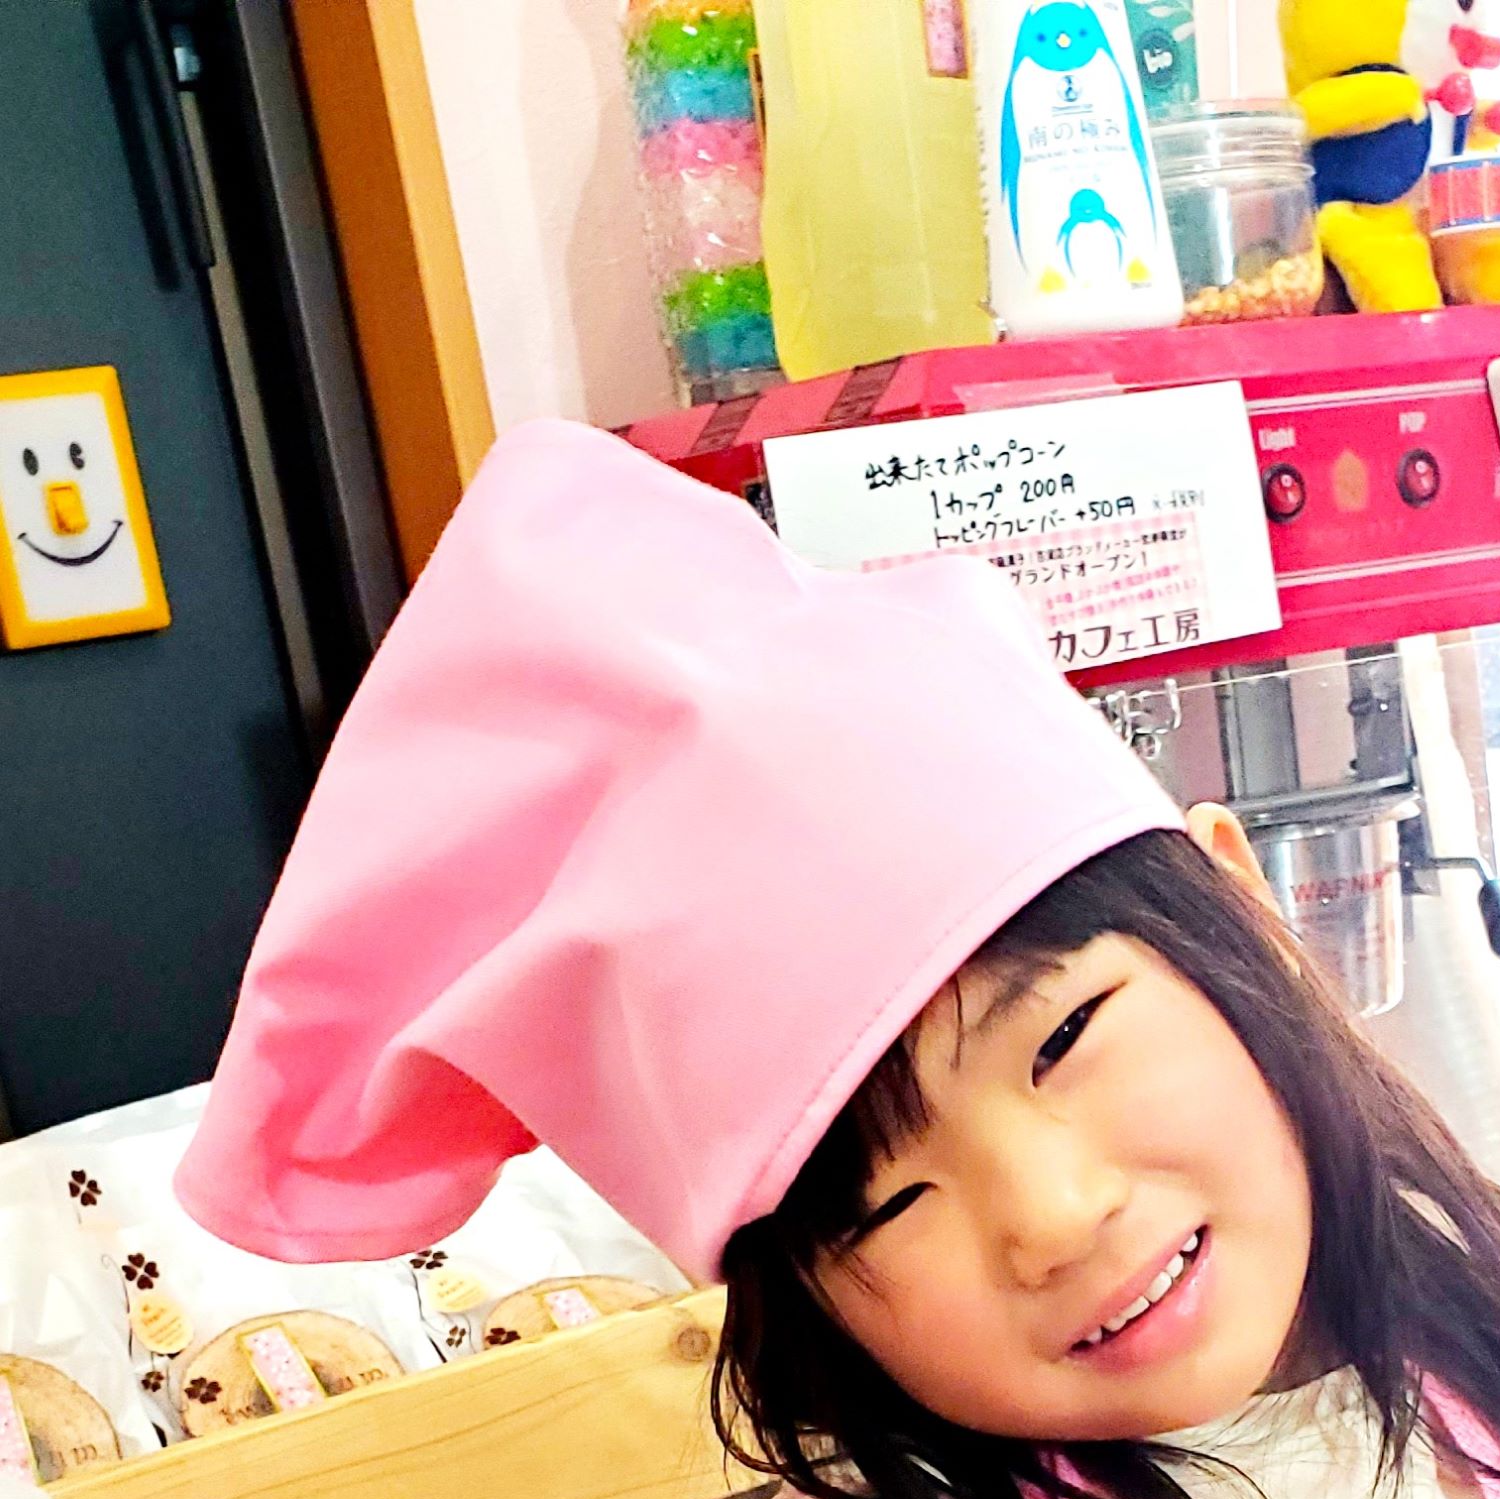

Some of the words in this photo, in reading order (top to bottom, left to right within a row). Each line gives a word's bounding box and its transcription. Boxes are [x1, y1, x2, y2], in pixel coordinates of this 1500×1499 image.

[1258, 427, 1297, 452] Light
[865, 438, 1066, 491] 出来たてポップコーン
[1020, 473, 1076, 503] 200円
